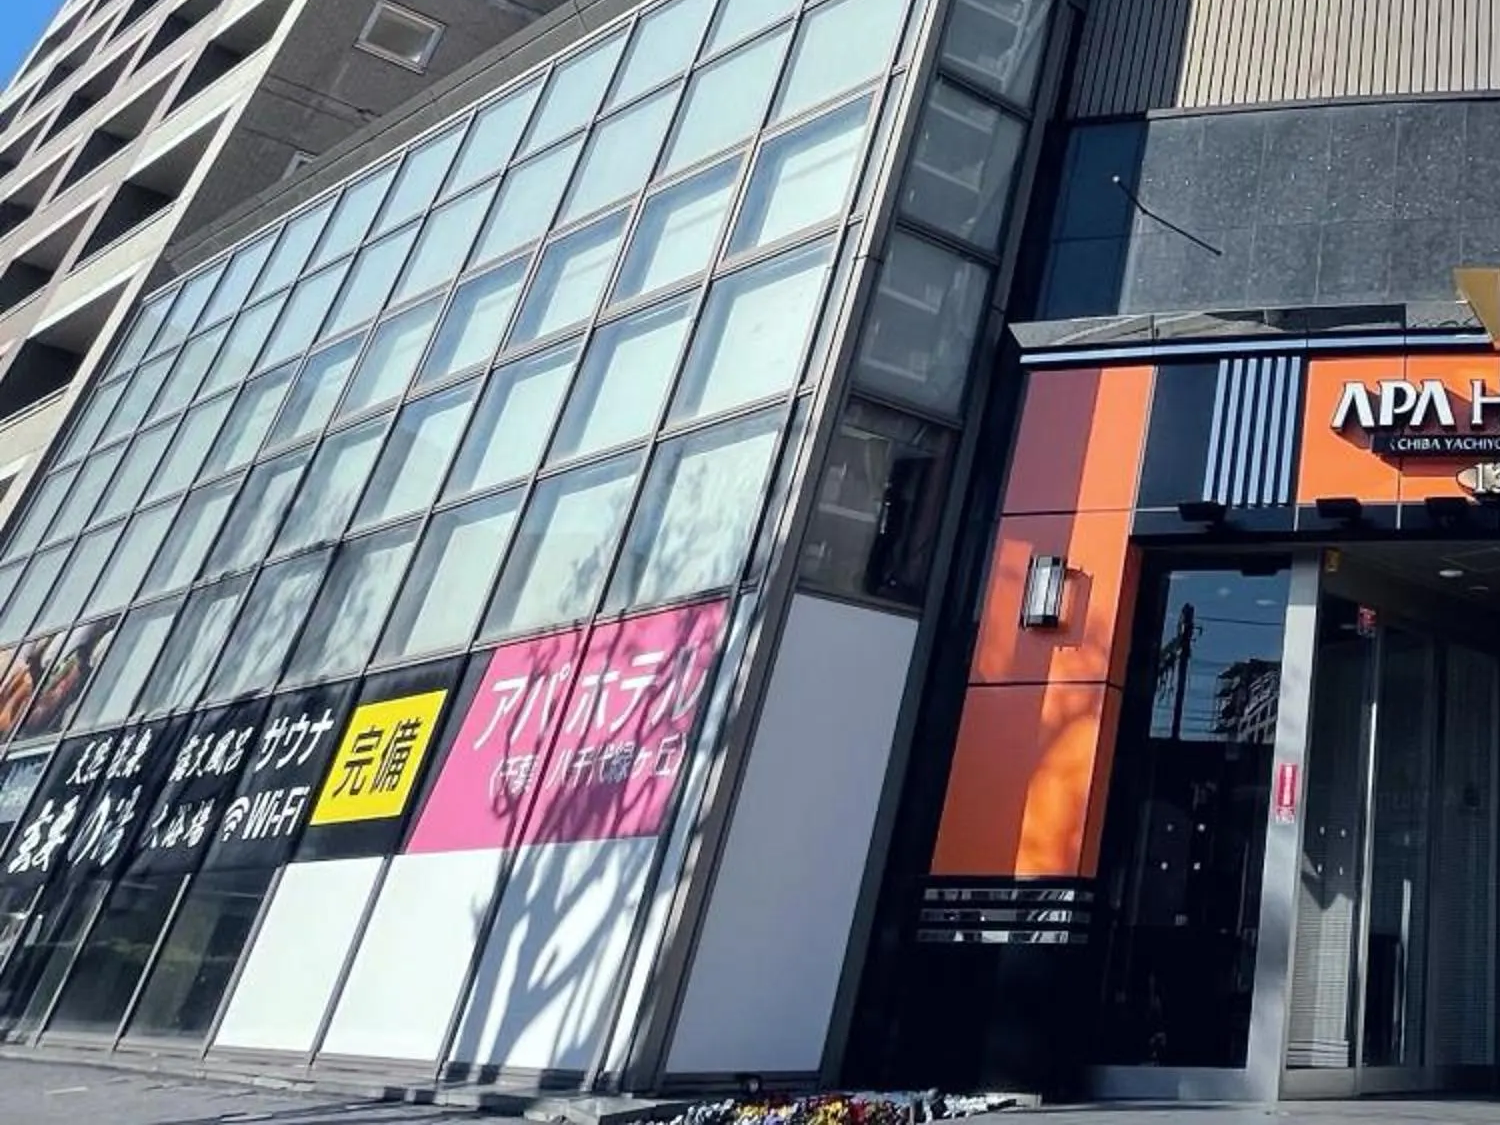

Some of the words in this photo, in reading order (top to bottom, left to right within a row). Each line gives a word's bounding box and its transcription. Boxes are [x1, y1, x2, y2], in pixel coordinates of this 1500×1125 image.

[1331, 379, 1455, 427] APA
[474, 645, 707, 750] アパホテル
[255, 708, 335, 772] サウナ
[332, 717, 422, 797] 完備
[241, 785, 310, 840] Wi-Fi
